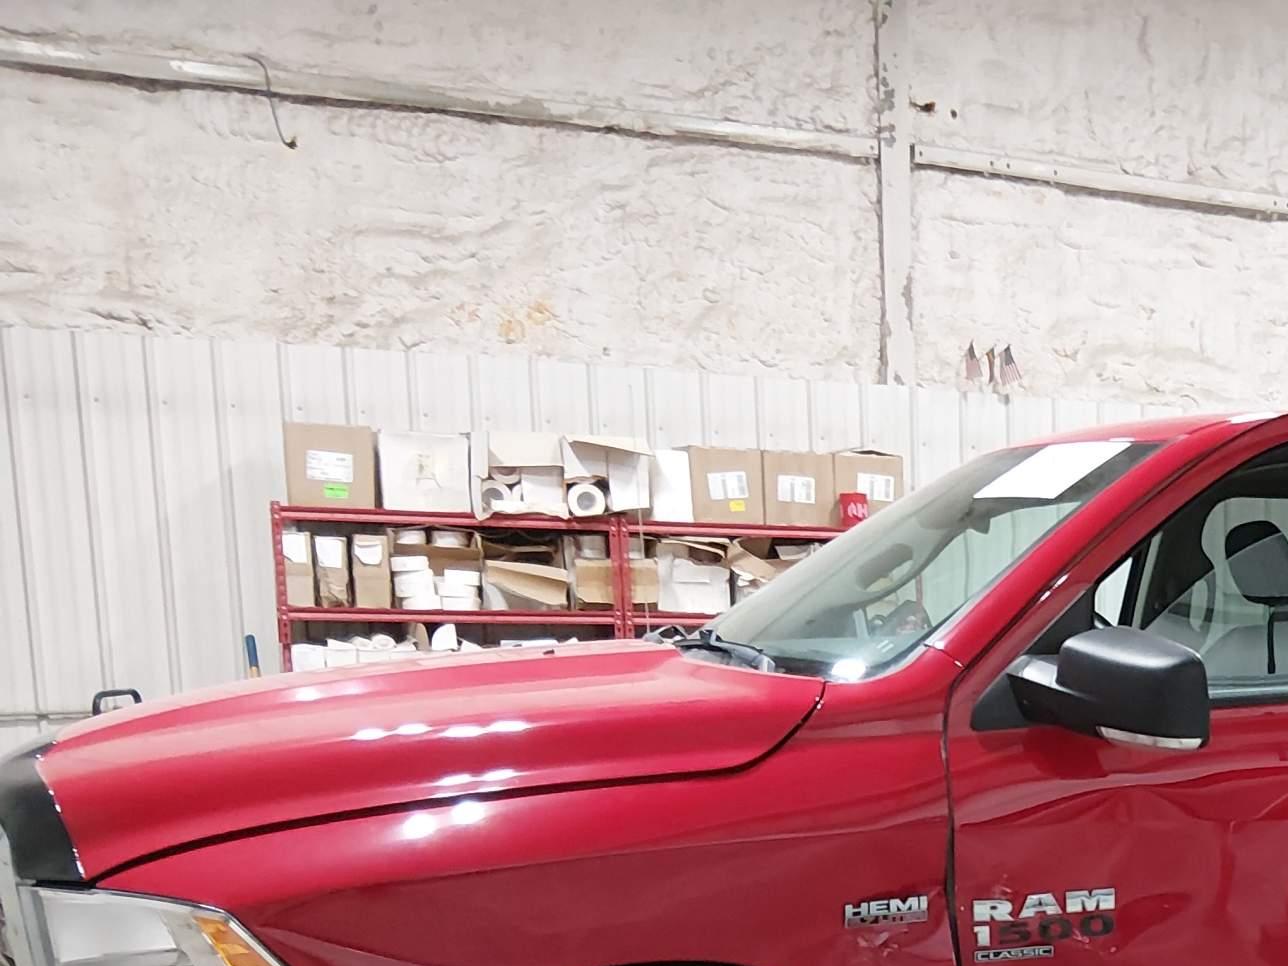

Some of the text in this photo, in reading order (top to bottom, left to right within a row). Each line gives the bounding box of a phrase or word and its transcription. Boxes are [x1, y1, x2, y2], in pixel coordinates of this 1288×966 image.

[845, 896, 928, 918] HEMI
[973, 888, 1115, 921] RAM
[973, 914, 1115, 946] 1500
[976, 946, 1054, 962] CLASSIC
